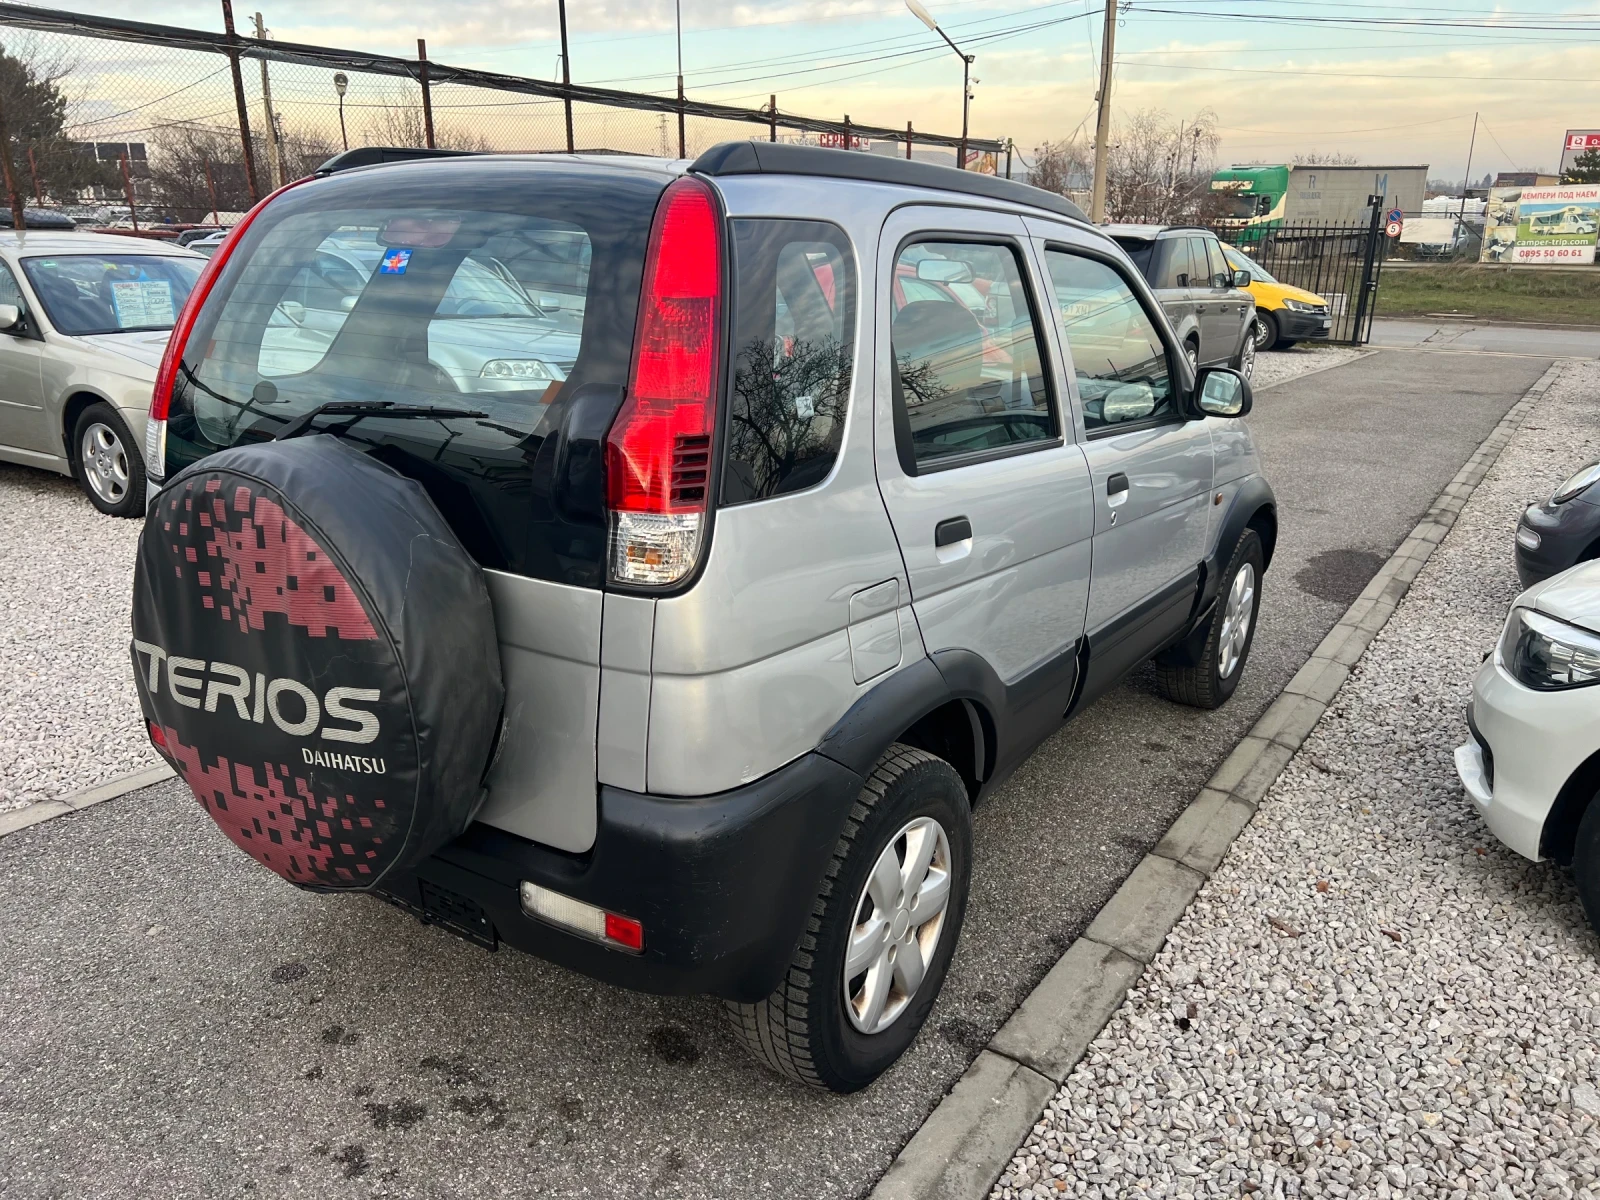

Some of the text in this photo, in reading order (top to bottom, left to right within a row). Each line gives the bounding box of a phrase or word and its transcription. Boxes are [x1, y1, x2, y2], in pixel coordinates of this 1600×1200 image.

[1521, 190, 1598, 200] КЕМПЕРИ ПОД НАЕМ
[1390, 224, 1396, 233] 5
[1516, 238, 1589, 247] camper-trip.com
[1519, 249, 1582, 258] 0895 50 60 61
[133, 638, 381, 744] TERIOS
[301, 747, 387, 775] DAIHATSU
